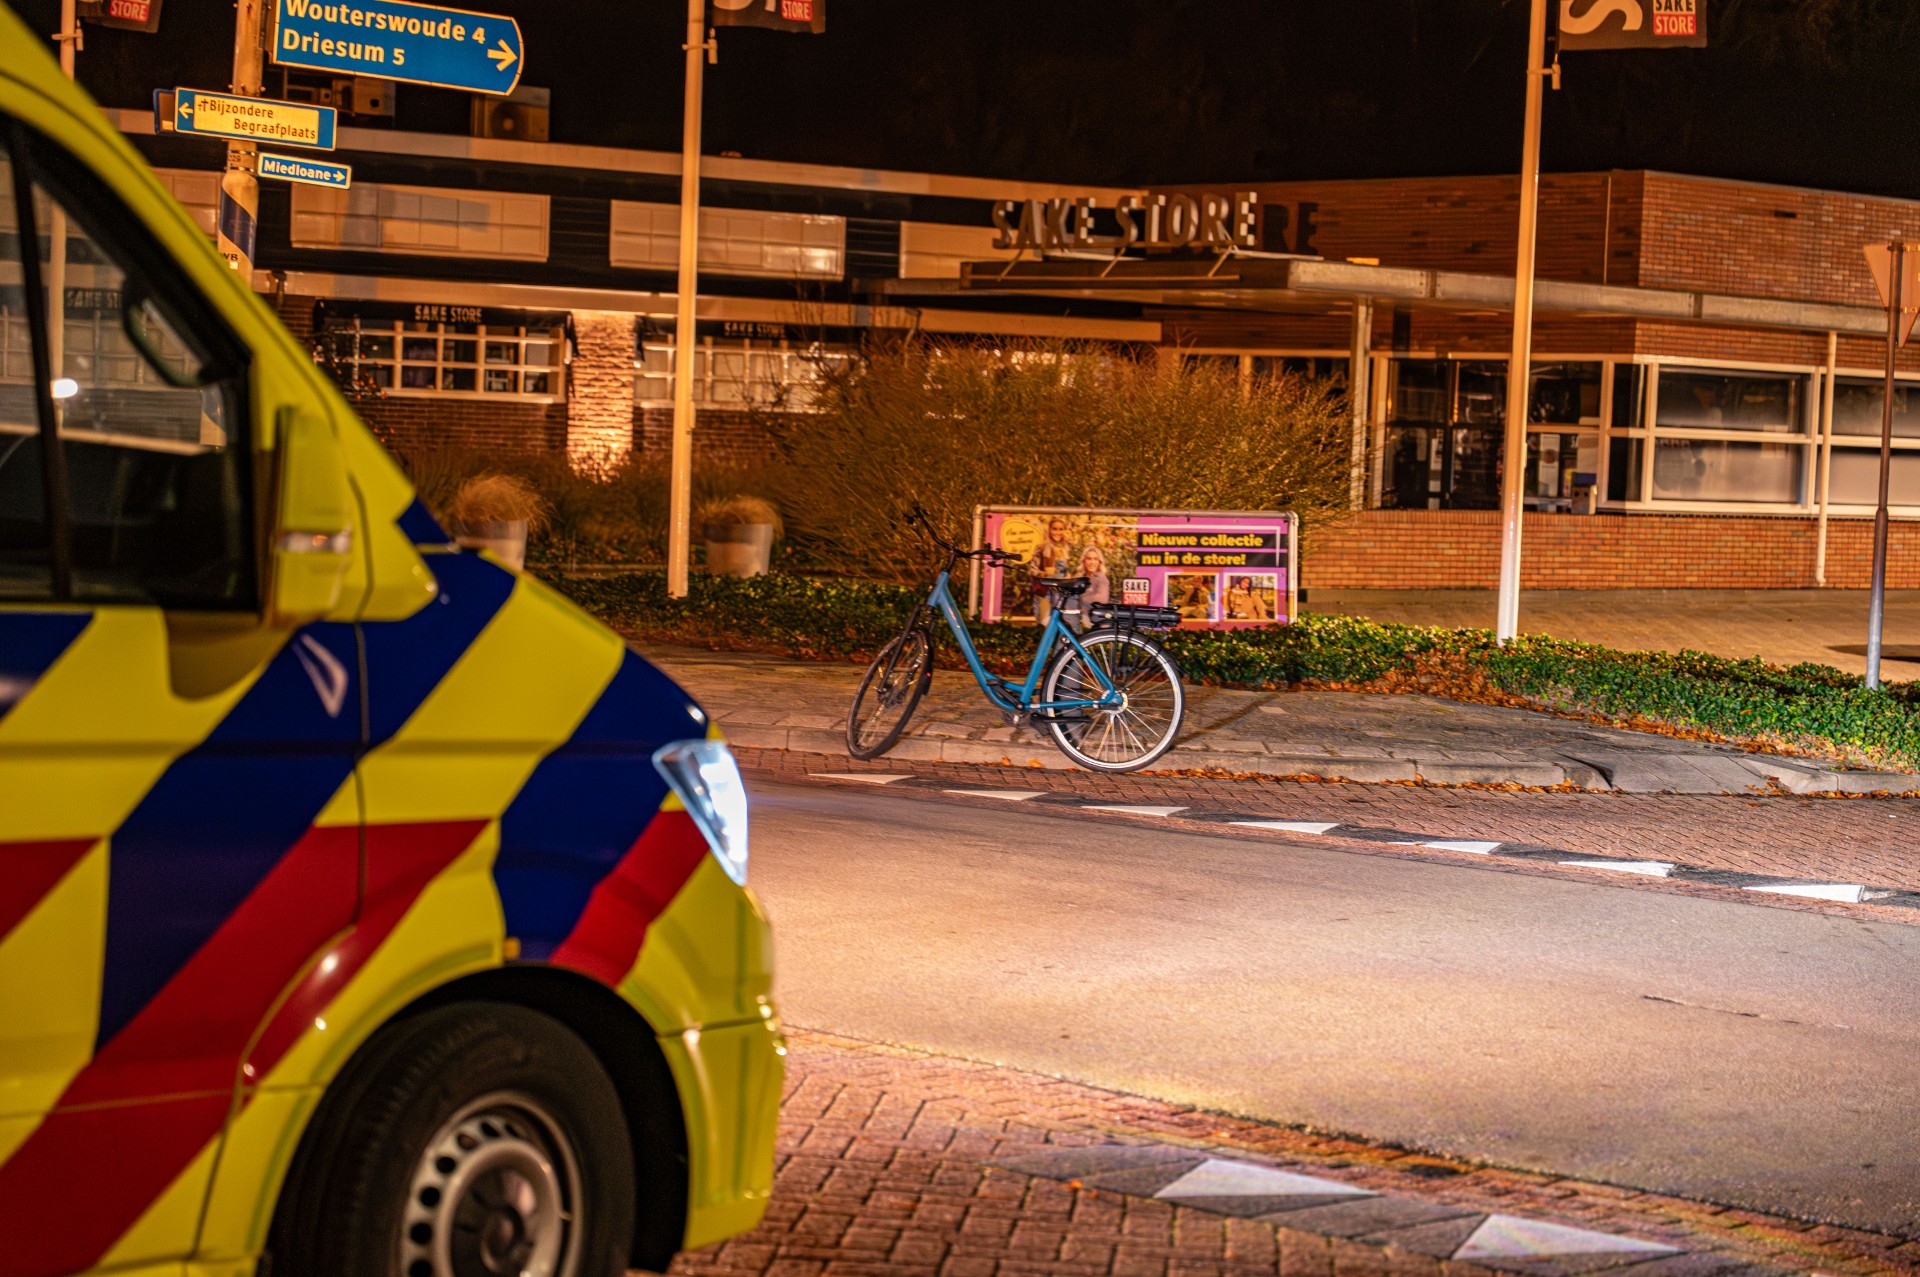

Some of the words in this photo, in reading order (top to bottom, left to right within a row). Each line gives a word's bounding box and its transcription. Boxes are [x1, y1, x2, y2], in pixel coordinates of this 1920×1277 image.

[111, 1, 148, 20] STORE
[783, 1, 811, 19] STORE
[285, 0, 466, 41] Wouterswoude
[472, 27, 486, 45] 4
[1656, 15, 1694, 34] STORE
[283, 28, 384, 63] Driesum
[392, 48, 405, 66] 5
[210, 100, 274, 118] Bijzondere
[234, 119, 316, 140] Begraafplaats
[264, 160, 331, 181] Miedloane
[992, 197, 1096, 249] SAKE
[1115, 192, 1257, 247] STORE
[415, 304, 447, 322] SAKE
[450, 307, 482, 323] STORE
[1142, 533, 1198, 546] Nieuwe
[1200, 533, 1264, 547] collectie
[1142, 554, 1162, 564] nu
[1164, 552, 1179, 564] in
[1181, 552, 1201, 565] de
[1203, 553, 1247, 565] store!
[1125, 581, 1147, 591] SAKE
[1123, 594, 1148, 605] STORE
